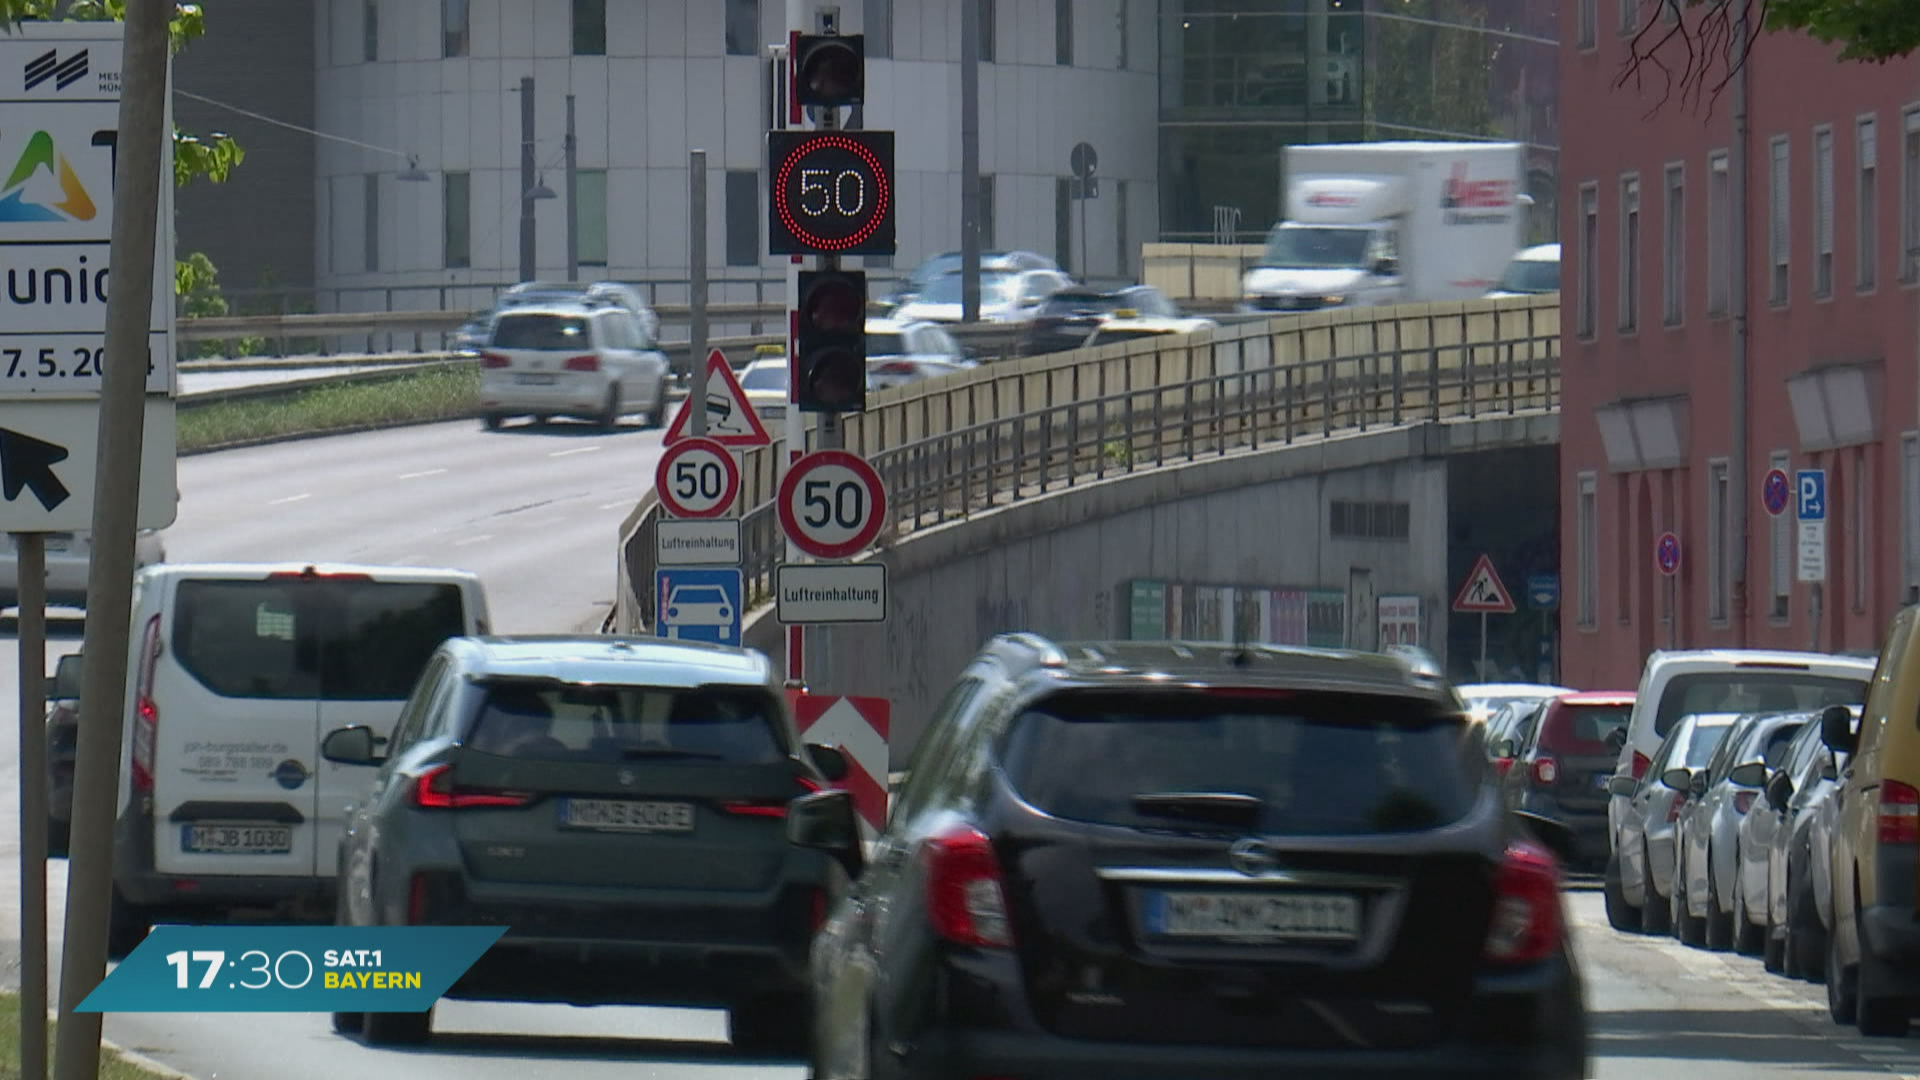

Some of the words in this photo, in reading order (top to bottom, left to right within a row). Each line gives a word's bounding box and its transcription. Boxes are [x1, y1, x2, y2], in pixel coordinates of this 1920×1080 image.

[98, 72, 122, 81] MES
[801, 168, 864, 217] 50
[676, 462, 722, 500] 50
[1801, 476, 1818, 515] P
[804, 480, 864, 530] 50
[661, 535, 736, 551] Luftreinhaltung
[784, 586, 879, 605] Luftreinhaltung
